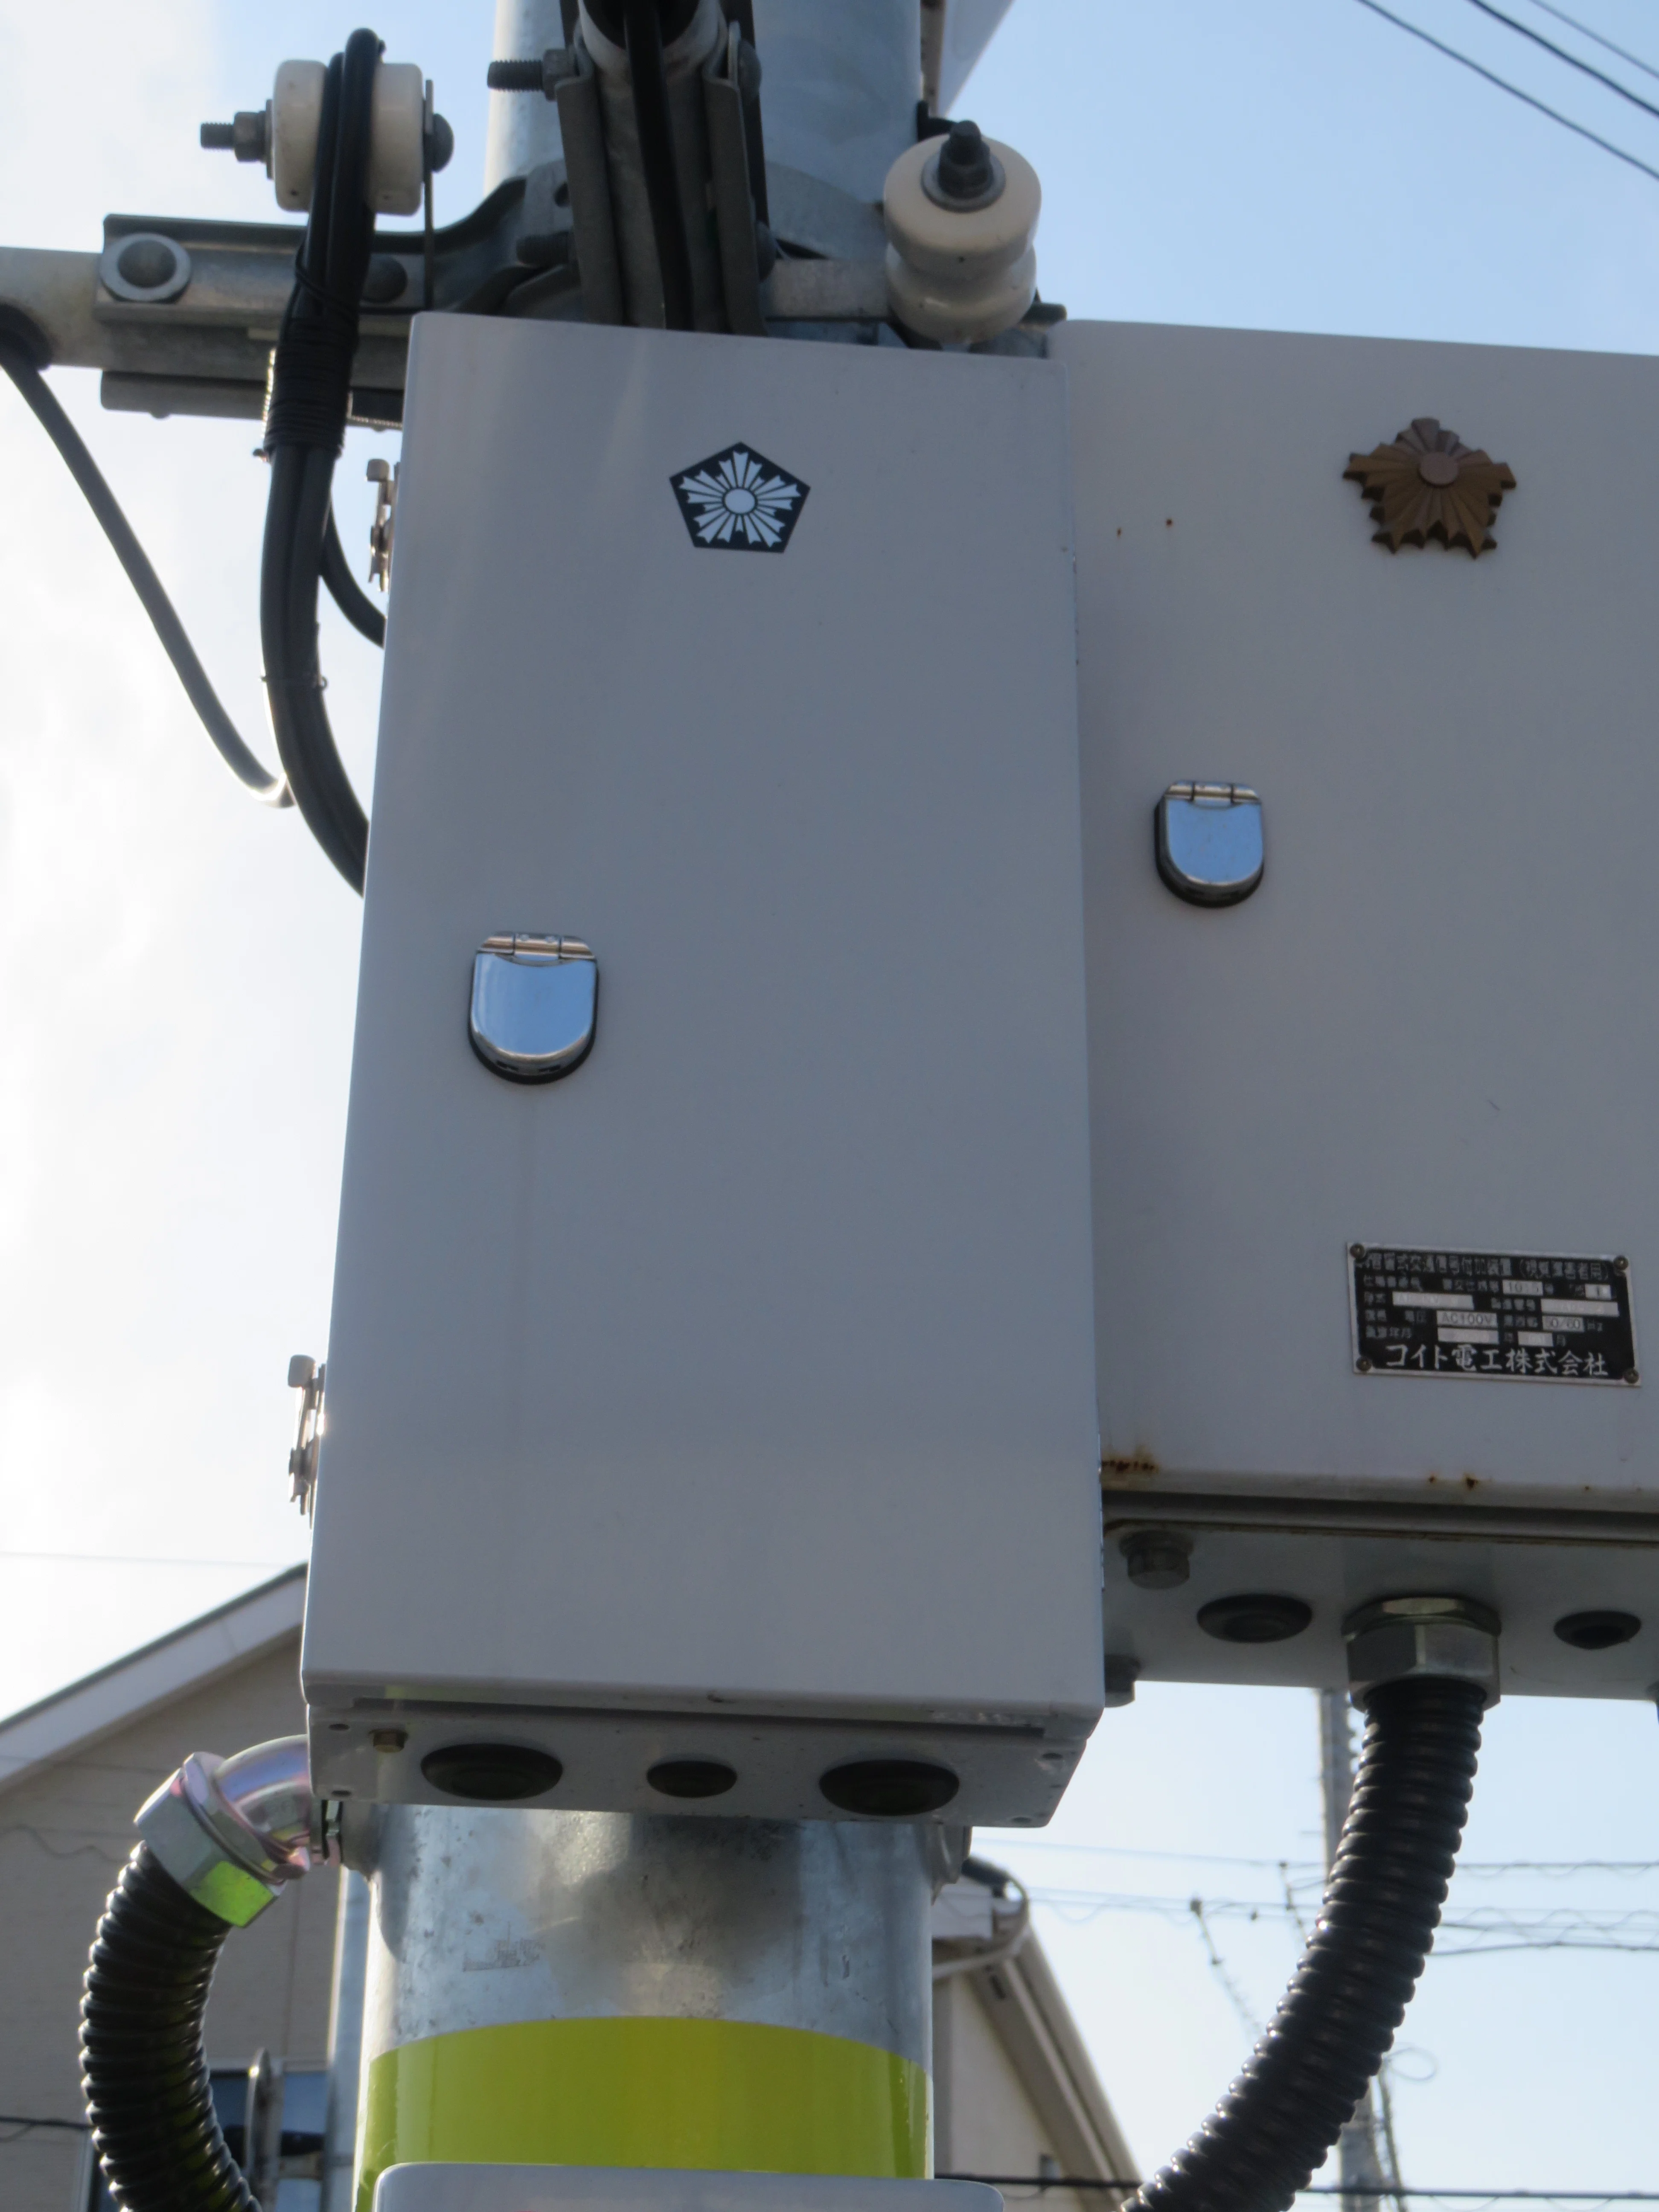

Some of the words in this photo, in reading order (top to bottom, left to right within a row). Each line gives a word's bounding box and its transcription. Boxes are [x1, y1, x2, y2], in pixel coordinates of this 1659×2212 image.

[1441, 1311, 1492, 1326] AC100V
[1386, 1345, 1609, 1377] コイト電工株式会社
